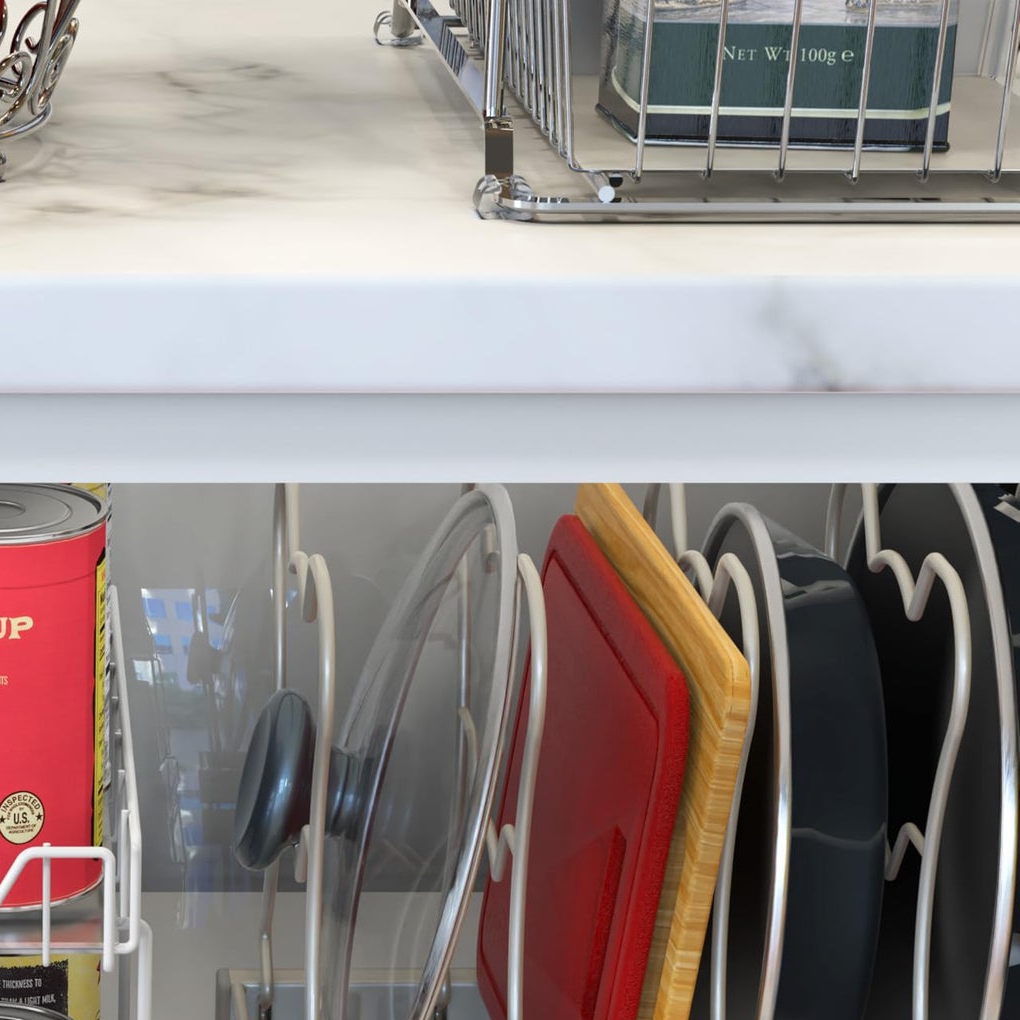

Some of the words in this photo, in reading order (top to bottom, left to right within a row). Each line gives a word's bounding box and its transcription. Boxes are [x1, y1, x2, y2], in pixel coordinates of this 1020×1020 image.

[801, 47, 837, 66] 100g
[0, 794, 41, 813] INSPECTED
[13, 812, 30, 825] U.S.
[2, 979, 33, 989] THICKNESS
[34, 978, 43, 987] TO
